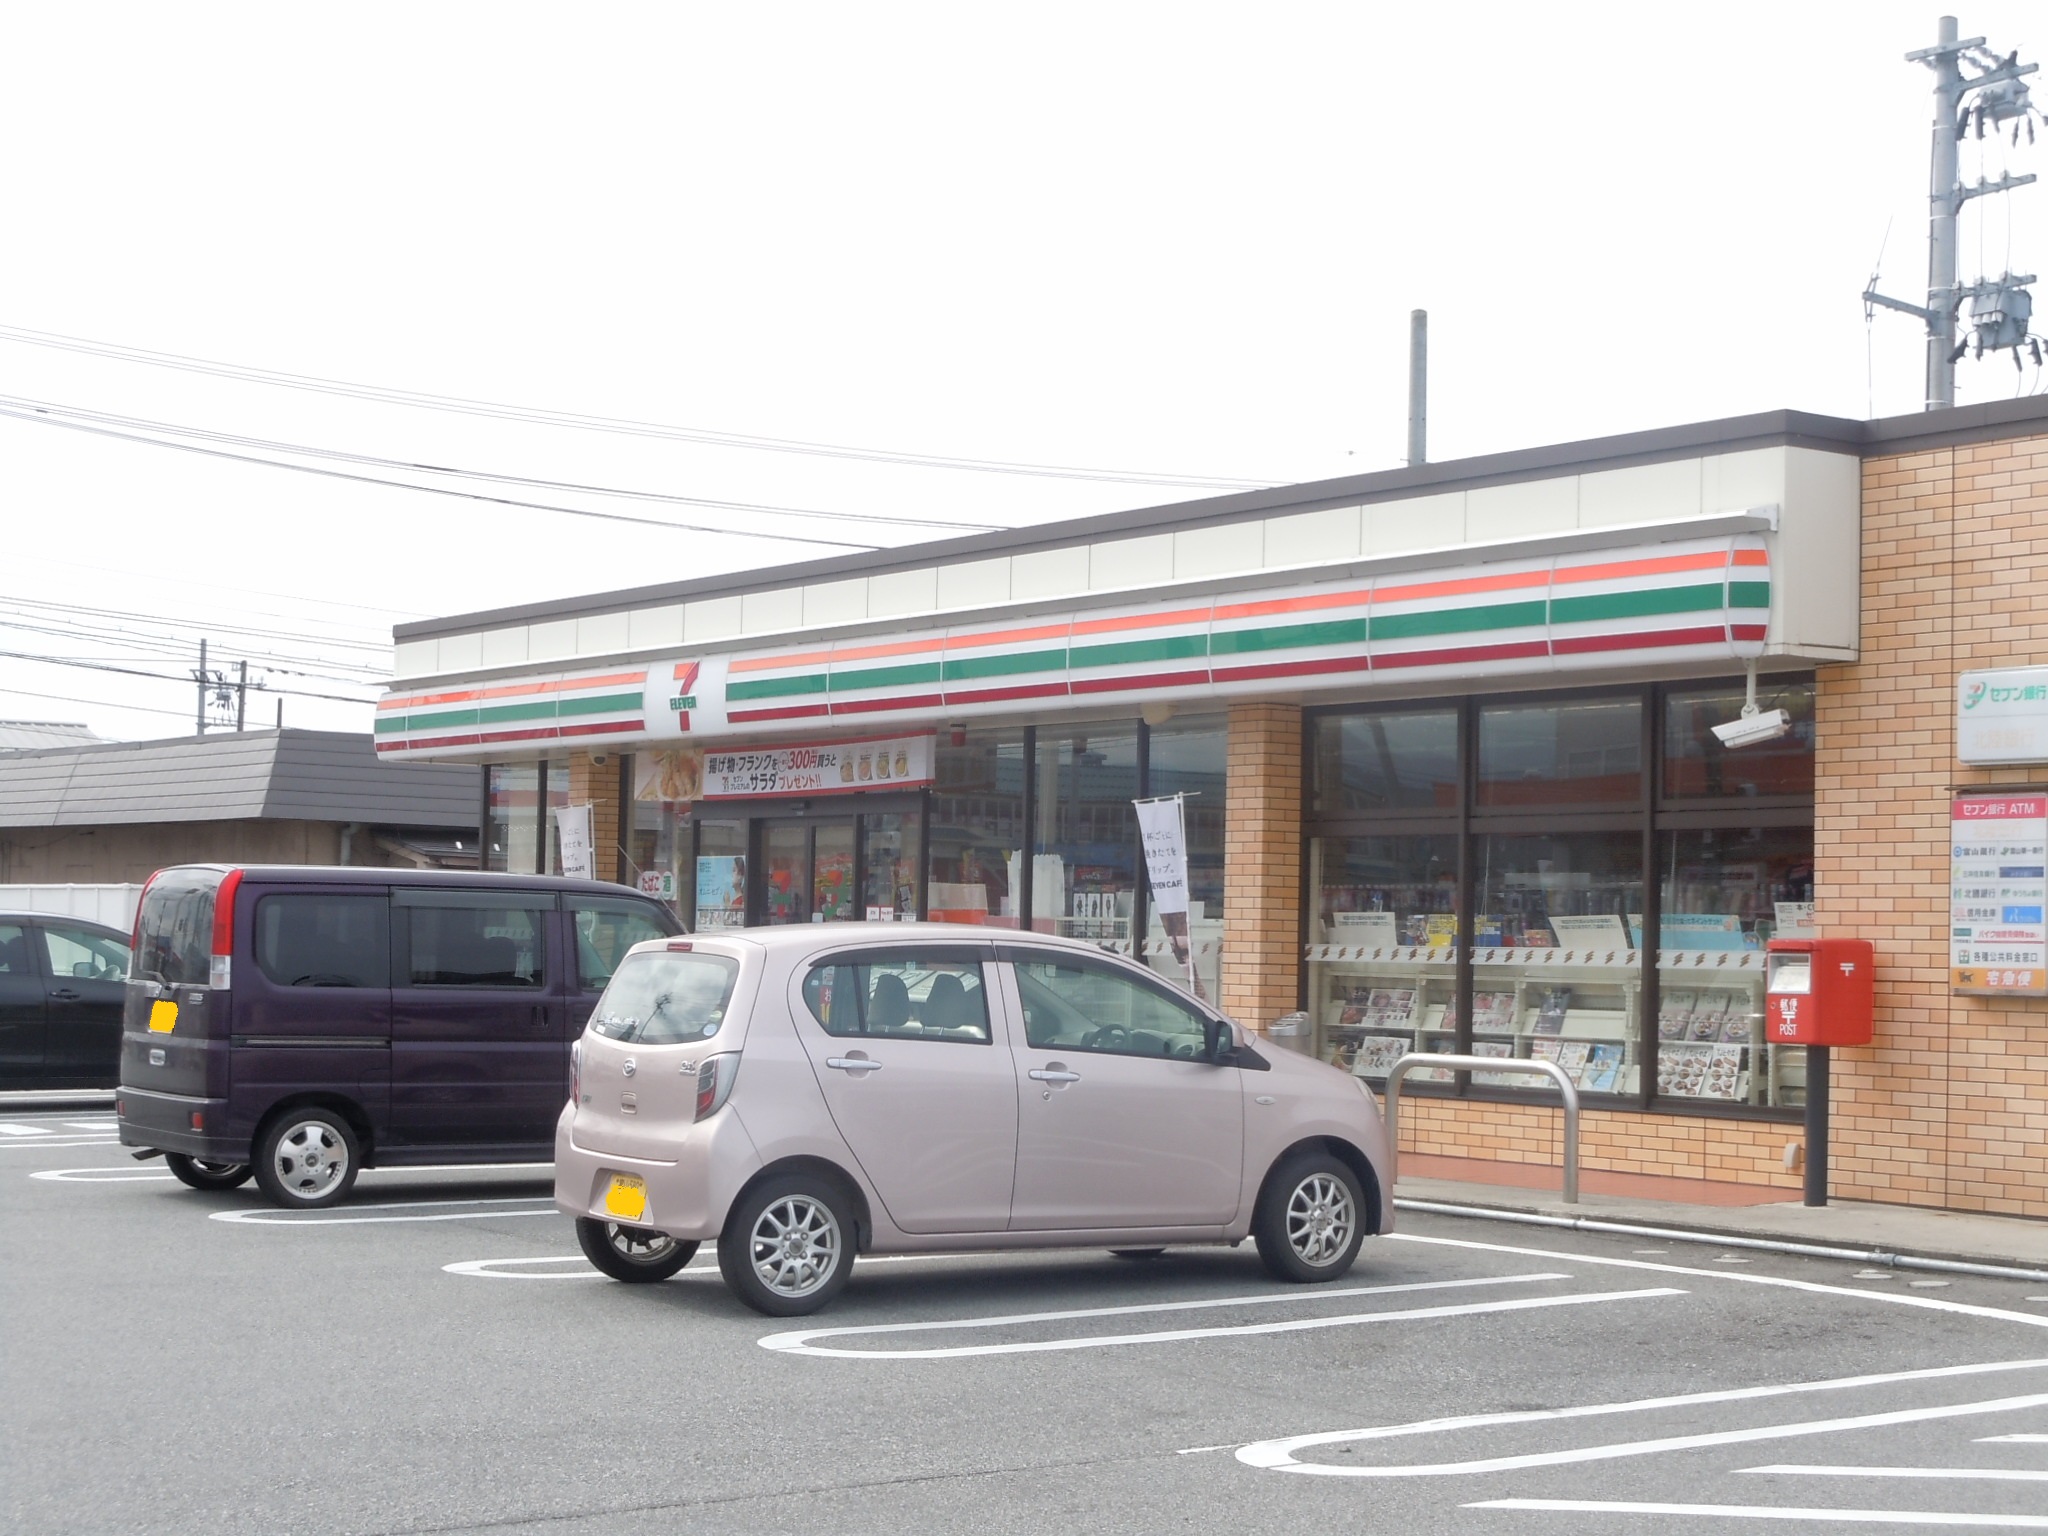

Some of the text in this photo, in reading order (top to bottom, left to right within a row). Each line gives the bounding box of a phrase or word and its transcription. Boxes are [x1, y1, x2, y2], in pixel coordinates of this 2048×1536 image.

[1990, 685, 2047, 702] セブン銀行
[750, 771, 778, 791] サラダ
[1963, 802, 2035, 816] セブン銀行 ATM
[642, 875, 660, 892] たばこ
[1974, 951, 2038, 963] 各種公共料金窓口
[1986, 970, 2032, 986] 宅急便
[1780, 998, 1798, 1012] 郵便
[1780, 1024, 1798, 1036] POST
